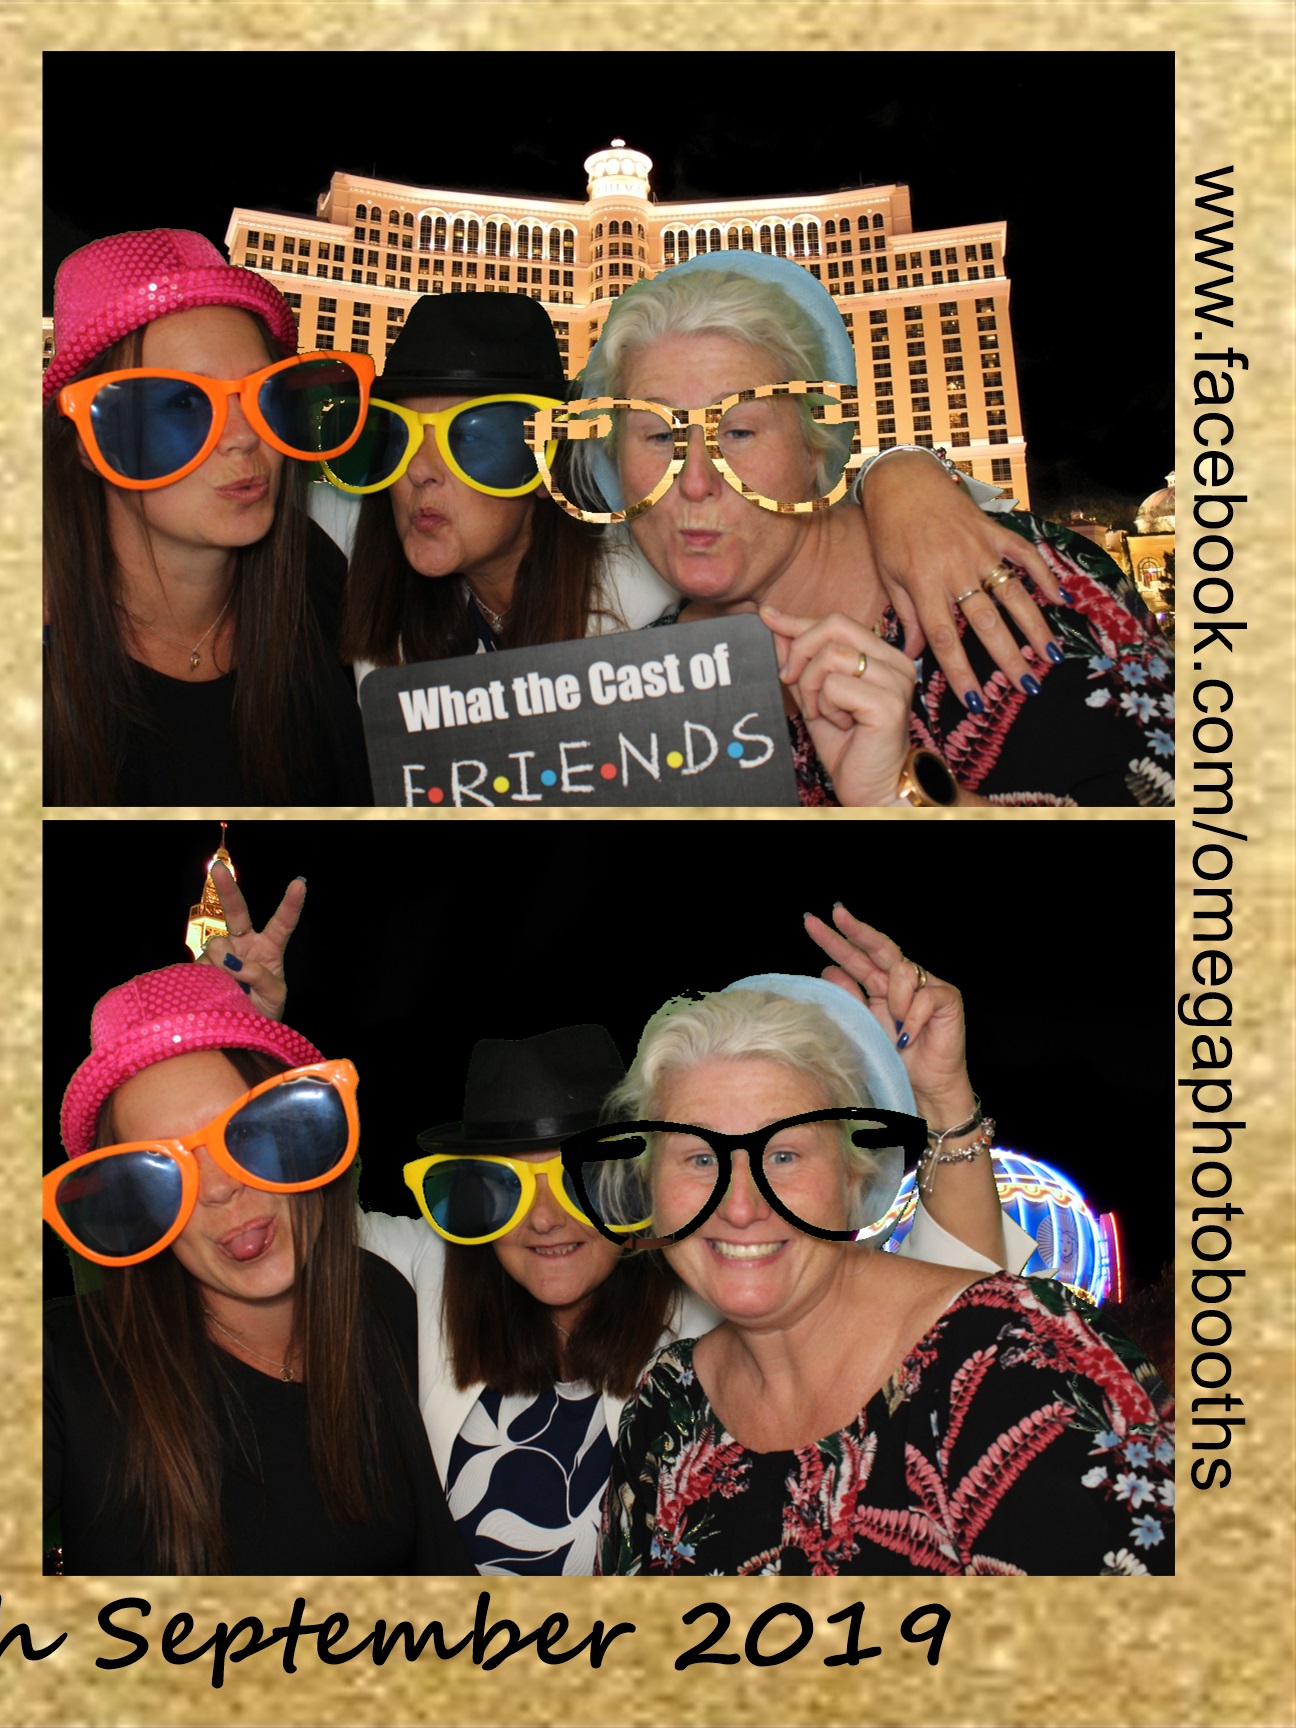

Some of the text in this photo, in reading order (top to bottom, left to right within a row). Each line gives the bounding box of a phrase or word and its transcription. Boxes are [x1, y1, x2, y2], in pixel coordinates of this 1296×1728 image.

[398, 642, 732, 733] What the Cast of
